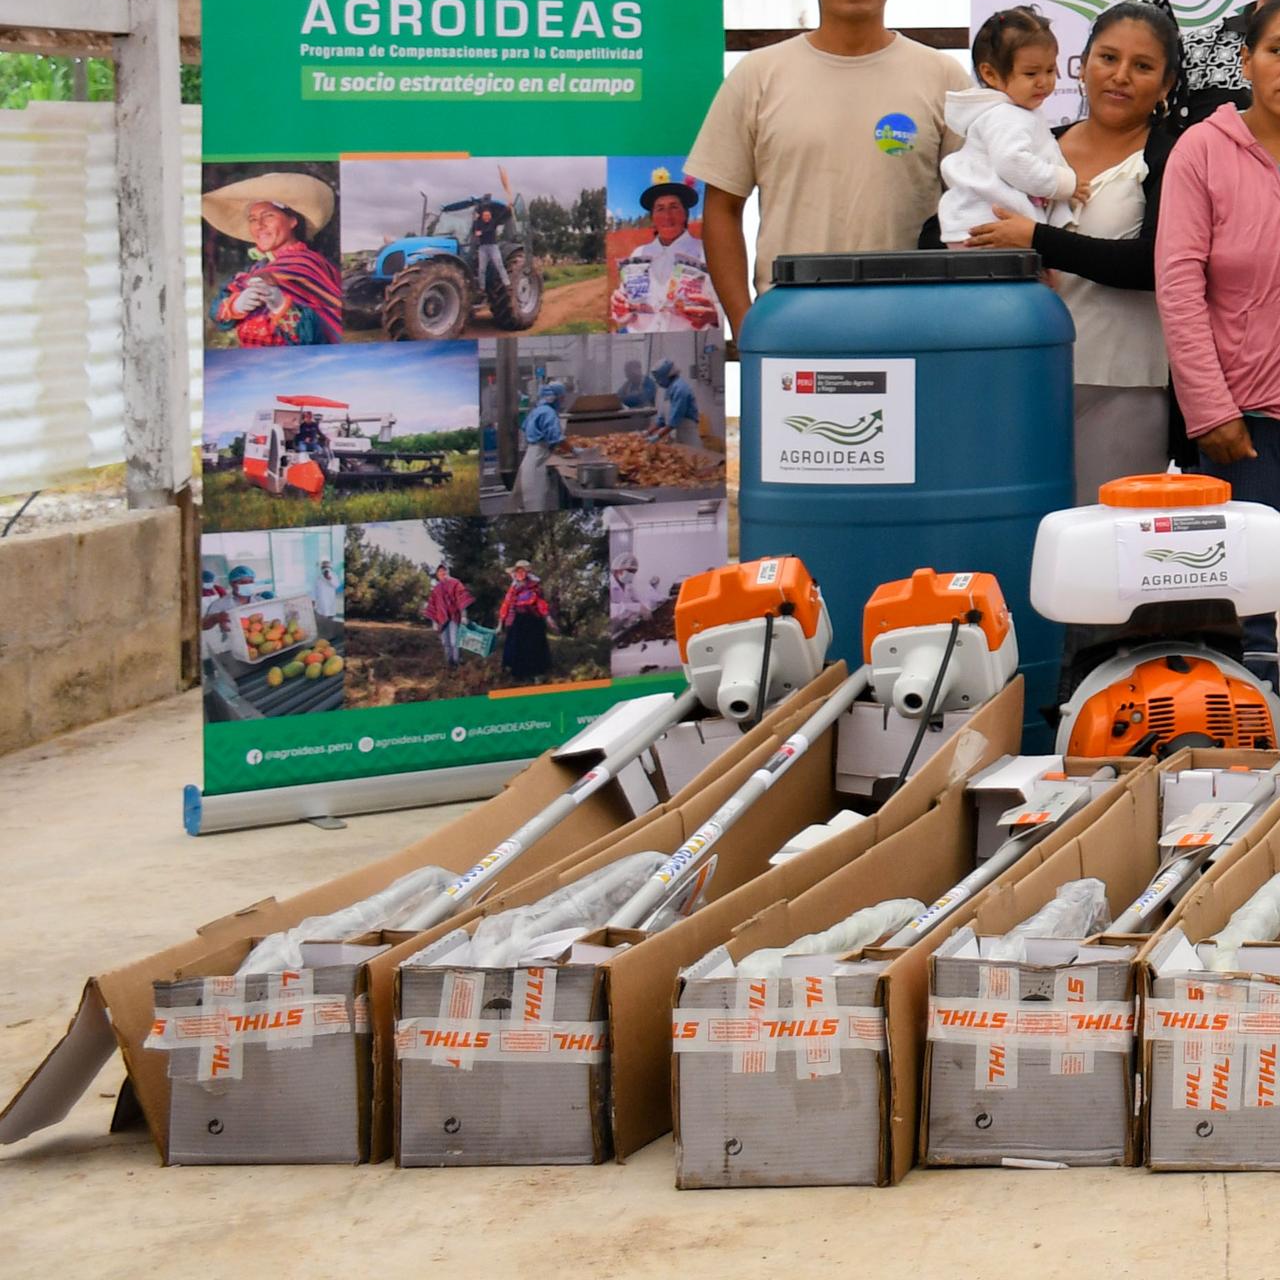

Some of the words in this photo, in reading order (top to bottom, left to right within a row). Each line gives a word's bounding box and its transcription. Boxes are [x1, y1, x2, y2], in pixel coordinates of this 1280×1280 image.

[300, 43, 364, 59] Programa
[369, 44, 385, 58] de
[389, 44, 498, 60] Compensaciones
[502, 47, 530, 62] para
[534, 46, 546, 60] la
[550, 46, 644, 62] Competitividad
[312, 72, 336, 92] Tu
[340, 73, 396, 93] socio
[399, 71, 516, 96] estratégico
[518, 76, 543, 93] en
[547, 72, 566, 93] el
[569, 76, 635, 96] campo
[780, 450, 886, 464] AGROIDEAS
[1141, 571, 1228, 587] AGROIDEAS
[264, 740, 354, 762] @agroideas.peru
[374, 731, 446, 750] agroideas.peru
[468, 720, 552, 739] @AGROIDEASPeru
[228, 1007, 304, 1033] STIHL
[762, 1018, 840, 1040] STIHL
[937, 1008, 1009, 1030] STIHL
[1156, 1010, 1230, 1031] STIHL
[420, 1028, 493, 1050] STIHL
